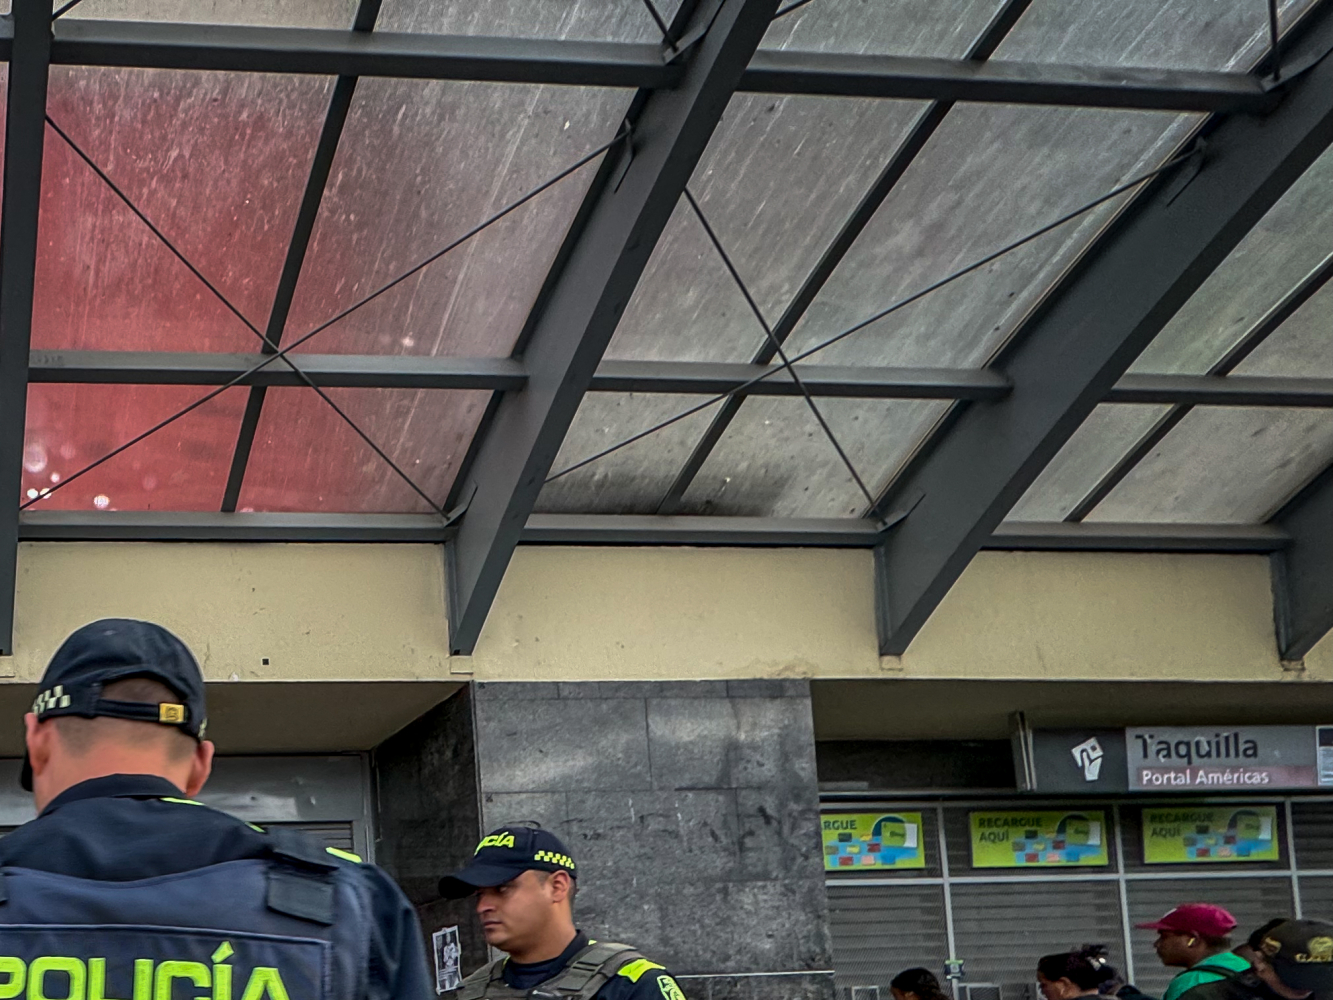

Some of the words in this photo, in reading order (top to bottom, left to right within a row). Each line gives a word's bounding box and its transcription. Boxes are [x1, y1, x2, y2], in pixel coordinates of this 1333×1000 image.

[1135, 731, 1258, 765] Taquilla
[1142, 769, 1191, 785] Portal
[1195, 768, 1269, 785] Américas
[823, 820, 857, 830] RGUE
[978, 817, 1042, 828] RECARGUE
[979, 829, 1009, 843] AQUÍ
